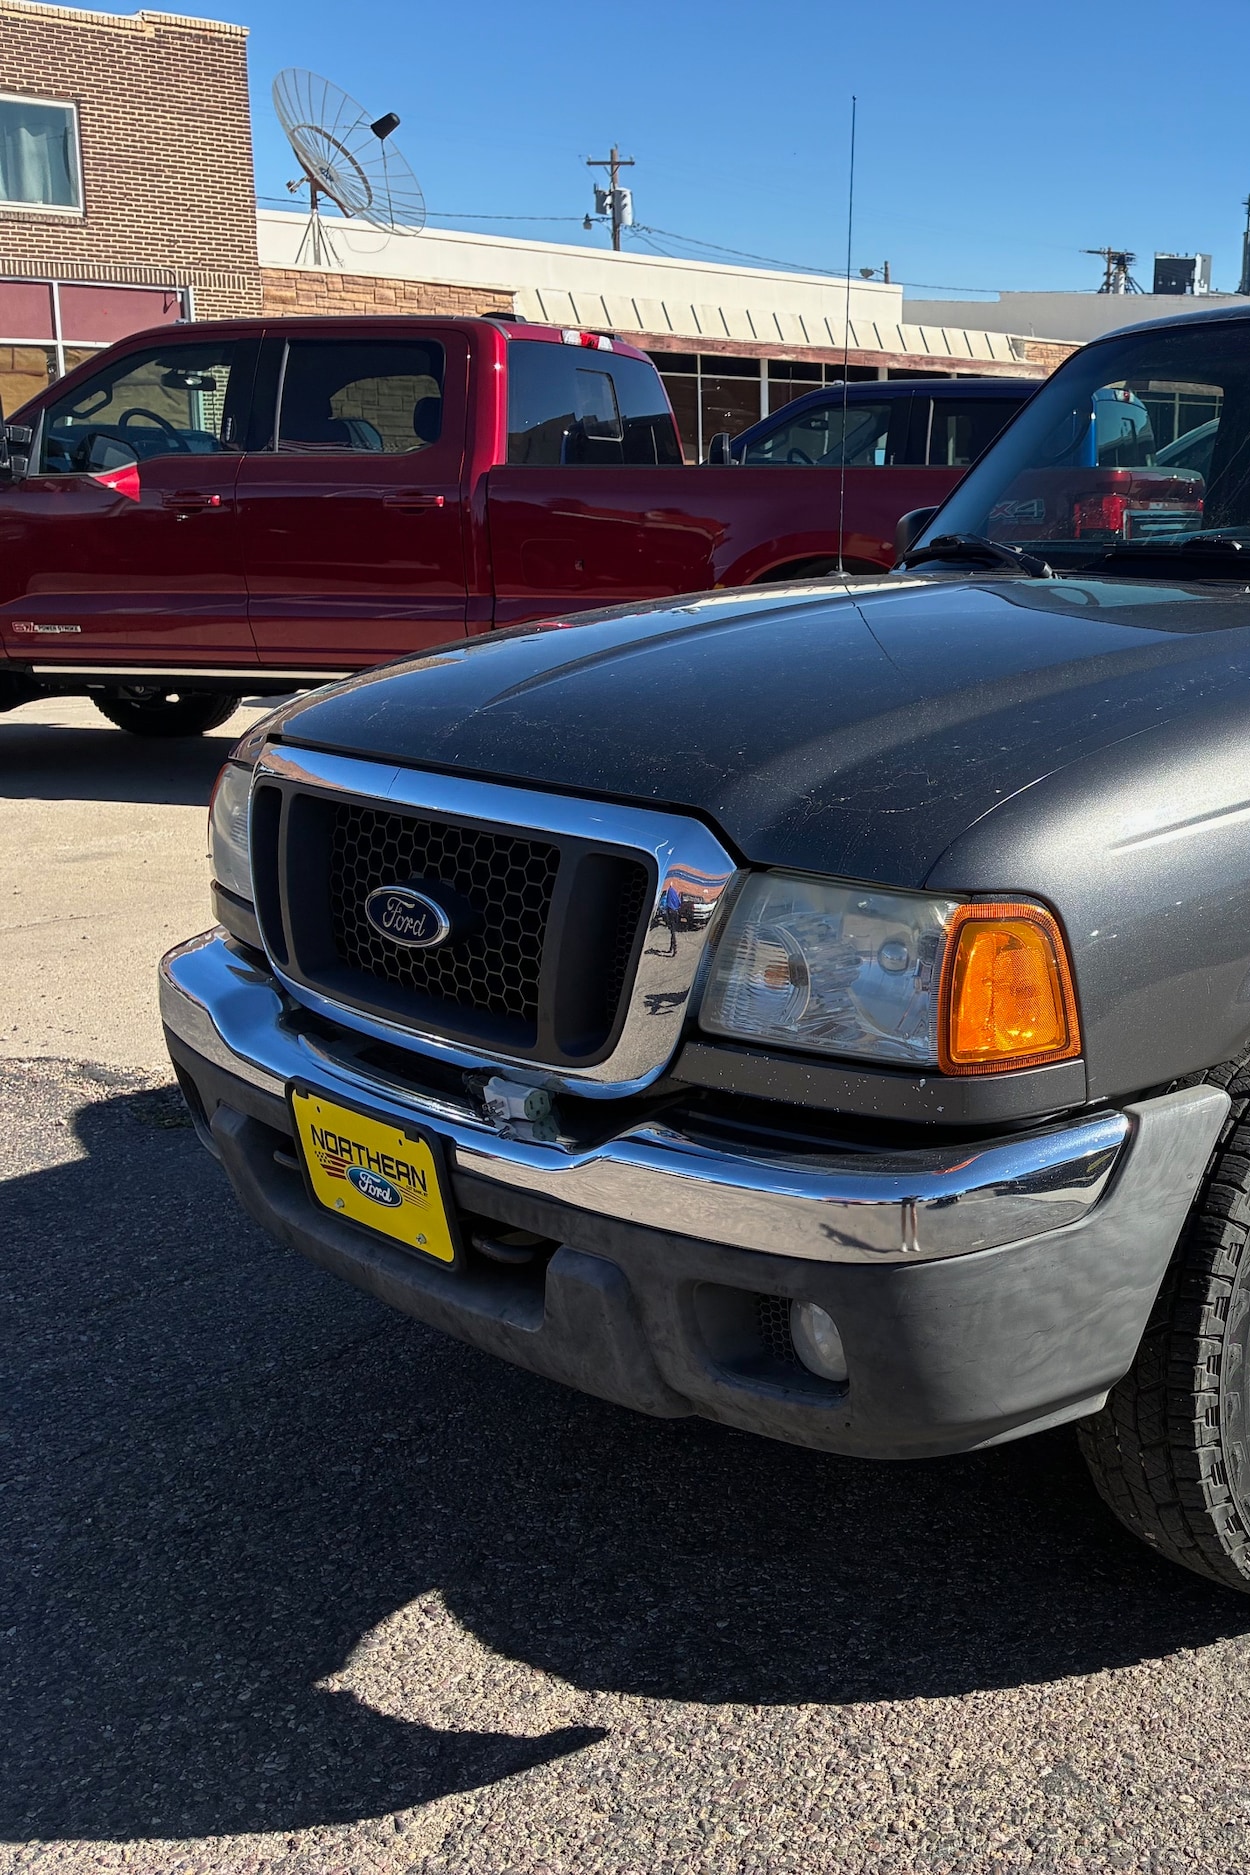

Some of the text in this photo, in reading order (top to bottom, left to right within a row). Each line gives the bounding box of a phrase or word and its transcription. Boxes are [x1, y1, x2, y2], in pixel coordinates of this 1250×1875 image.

[383, 896, 426, 937] Ford
[310, 1123, 428, 1192] NORTHERN
[358, 1170, 393, 1203] Ford
